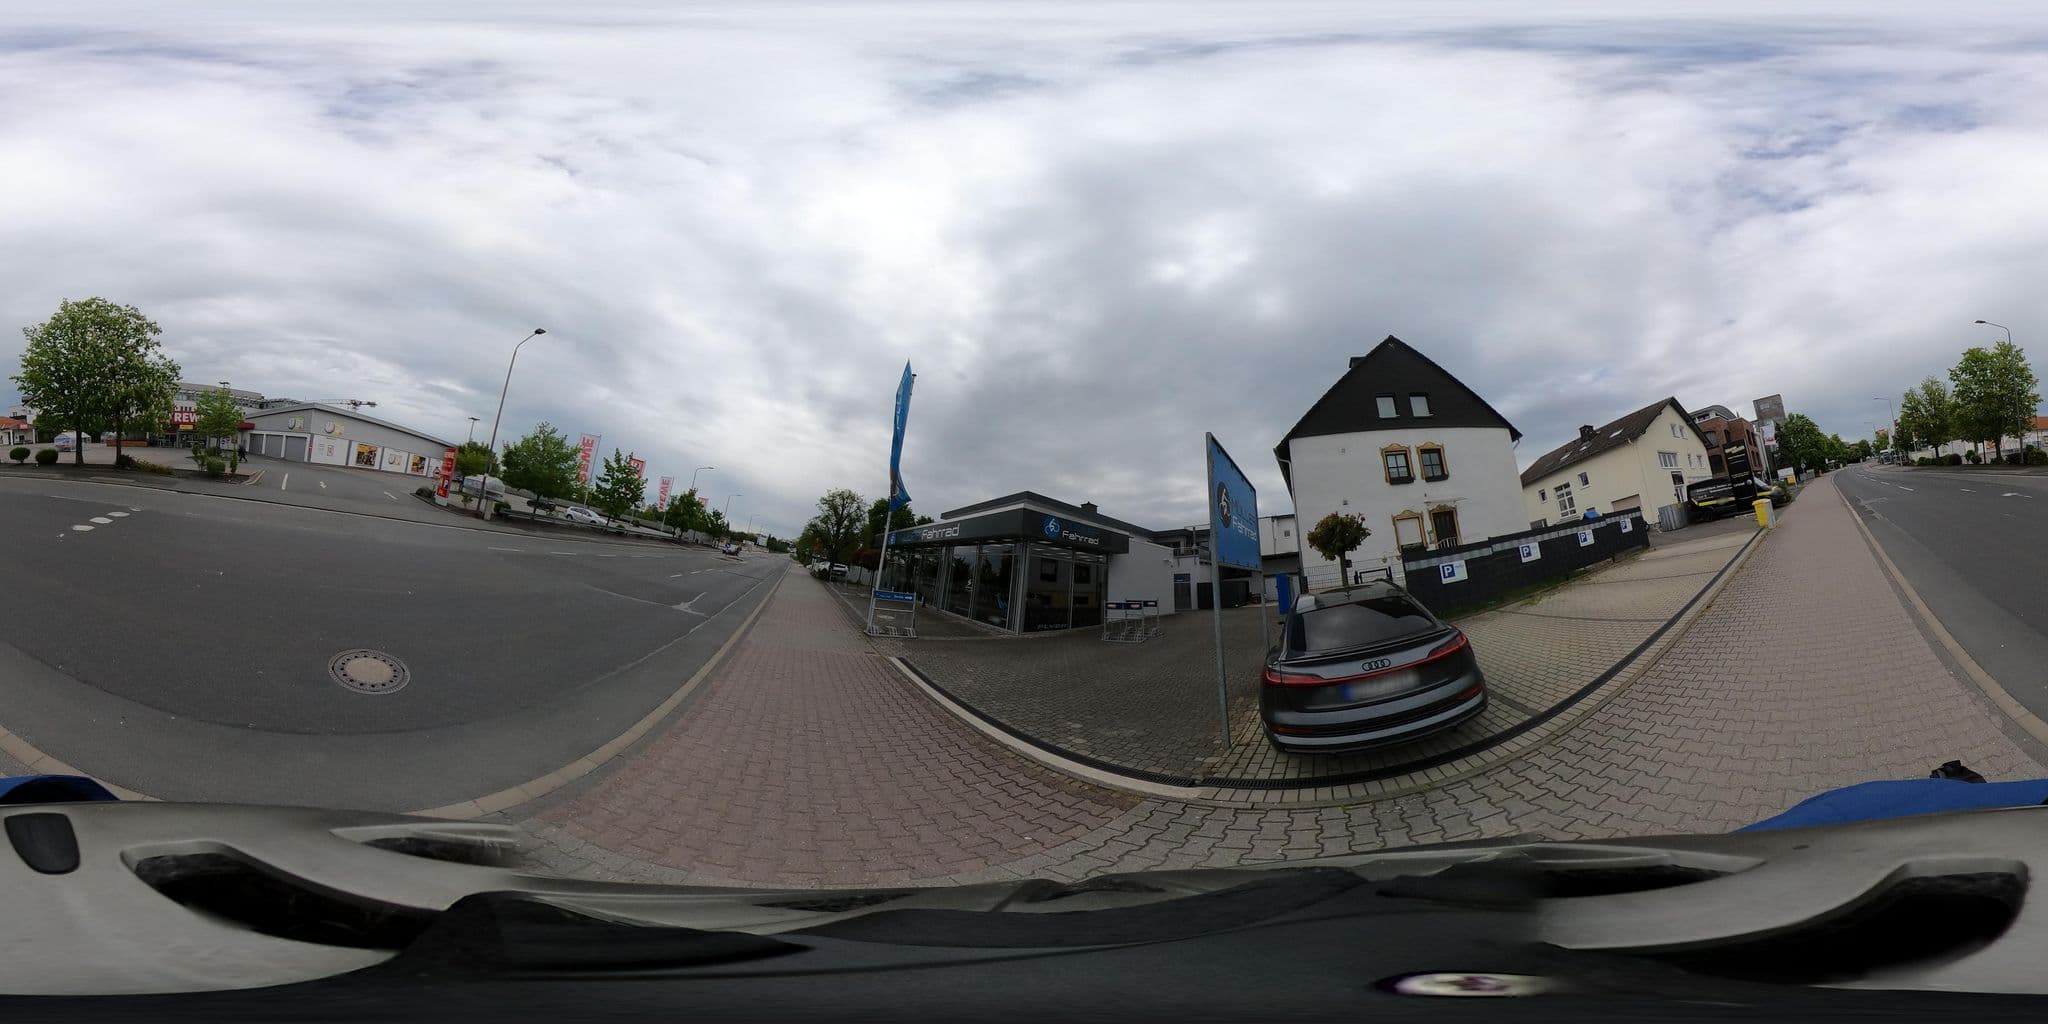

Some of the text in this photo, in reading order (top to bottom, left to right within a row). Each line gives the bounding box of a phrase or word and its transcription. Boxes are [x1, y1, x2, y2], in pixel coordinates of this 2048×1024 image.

[173, 412, 201, 422] REW
[921, 522, 960, 540] Fahrrad
[1062, 530, 1099, 545] Fahrrad
[1522, 546, 1530, 556] P
[1444, 566, 1453, 577] P
